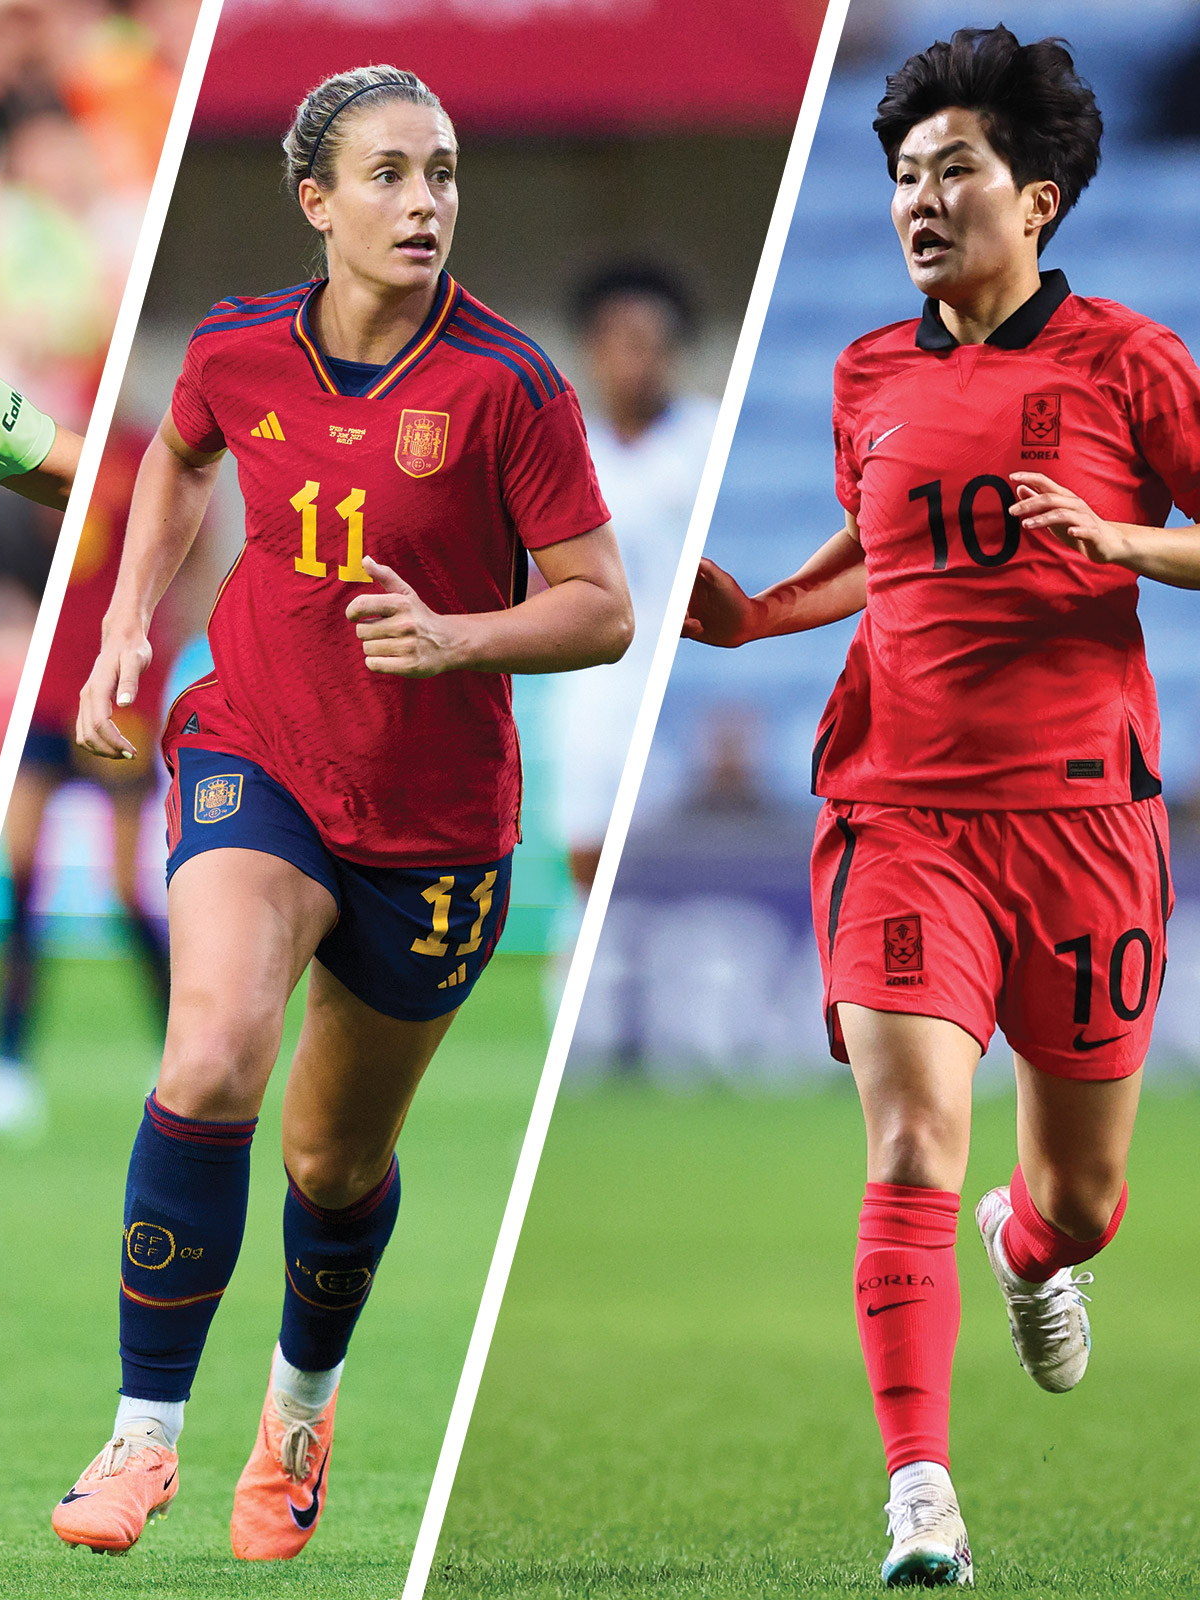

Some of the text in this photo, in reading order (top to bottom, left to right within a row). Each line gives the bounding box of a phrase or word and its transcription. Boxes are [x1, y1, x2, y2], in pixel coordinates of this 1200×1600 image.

[1, 391, 23, 433] Coll
[1021, 450, 1060, 460] KOREA
[289, 480, 374, 583] 11
[908, 474, 1021, 570] 10
[410, 869, 498, 957] 11
[885, 975, 924, 986] KOREA
[1054, 928, 1153, 1025] 10
[858, 1273, 935, 1294] KOREA
